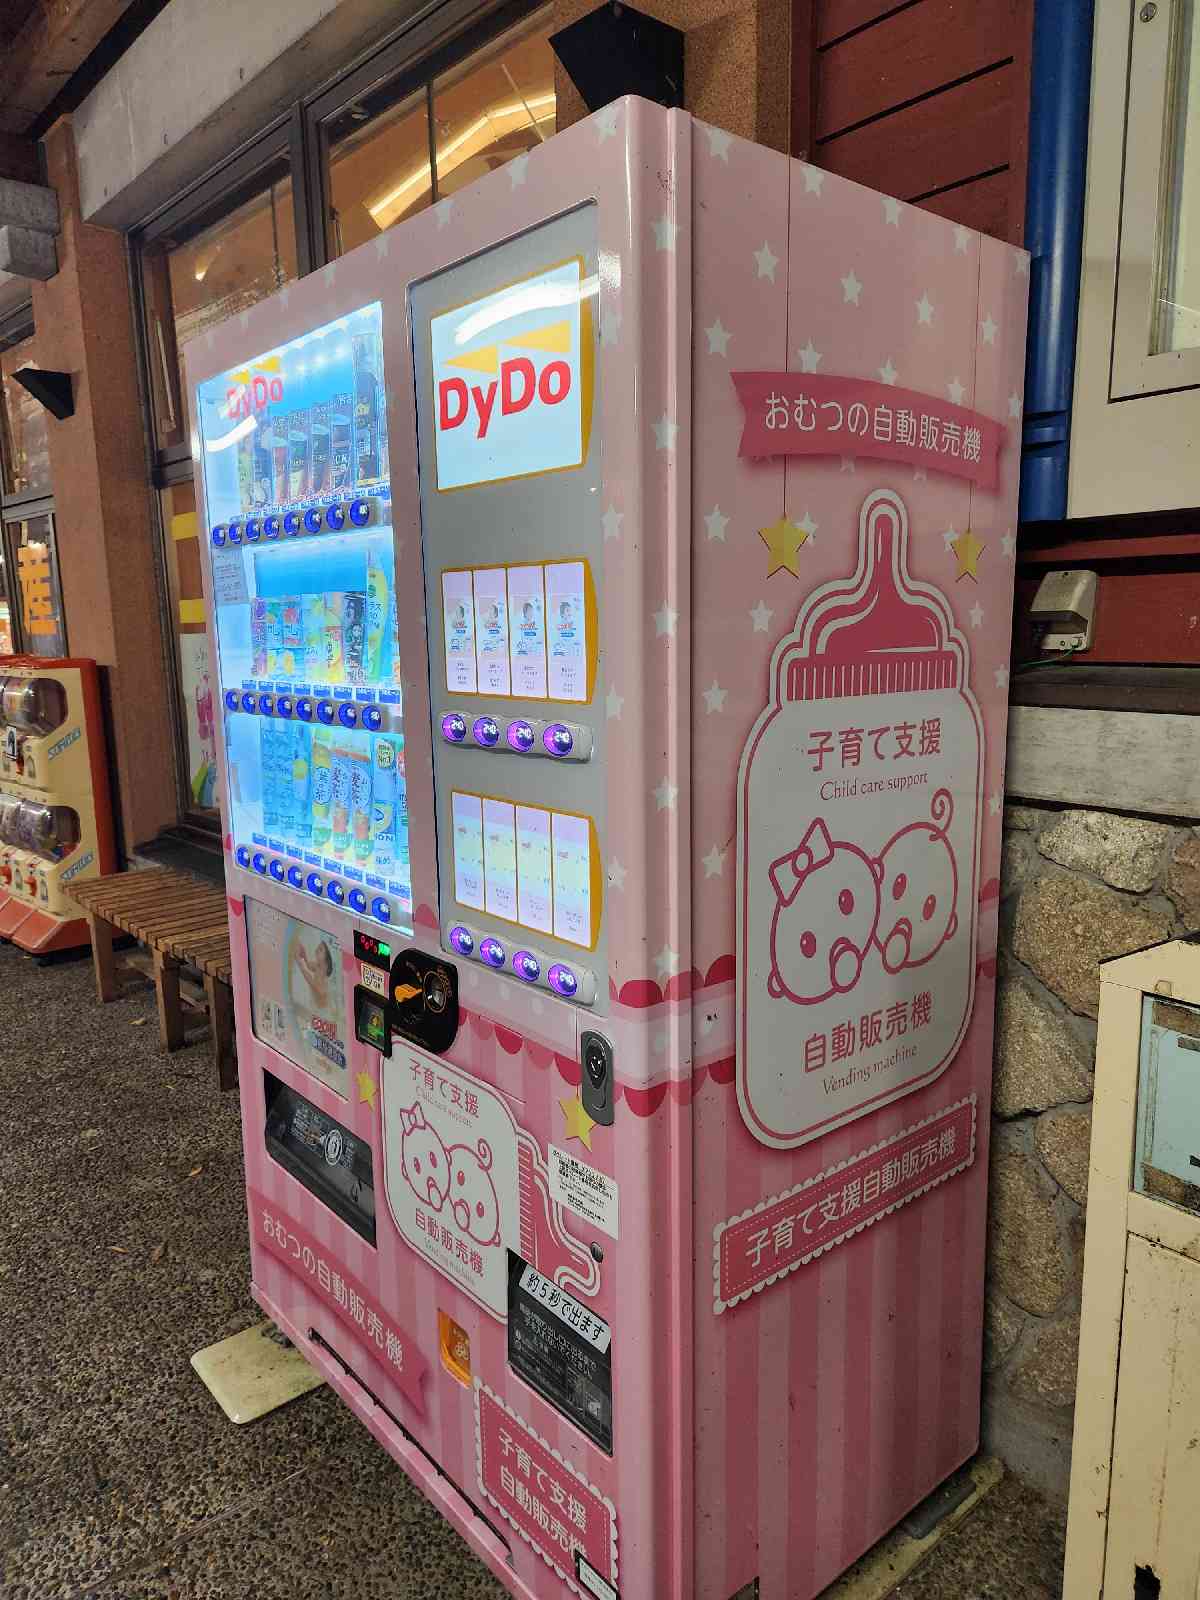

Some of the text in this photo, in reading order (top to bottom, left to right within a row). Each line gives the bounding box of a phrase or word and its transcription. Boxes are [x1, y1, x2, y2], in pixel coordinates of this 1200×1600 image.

[438, 357, 571, 439] DyDo
[765, 392, 981, 462] おむつの自動販売機
[807, 718, 941, 772] 子育て支援
[820, 771, 929, 800] Child care support
[803, 991, 932, 1073] 自動販売機
[409, 1057, 479, 1118] 子育て支援
[822, 1044, 918, 1095] Vending machine
[746, 1127, 956, 1268] 子育て支援自動販売機
[416, 1208, 484, 1277] 自動販売機
[262, 1210, 404, 1372] おむつの自動販売機
[526, 1272, 605, 1341] 約5秒で出ます
[498, 1428, 587, 1533] 子育て支援
